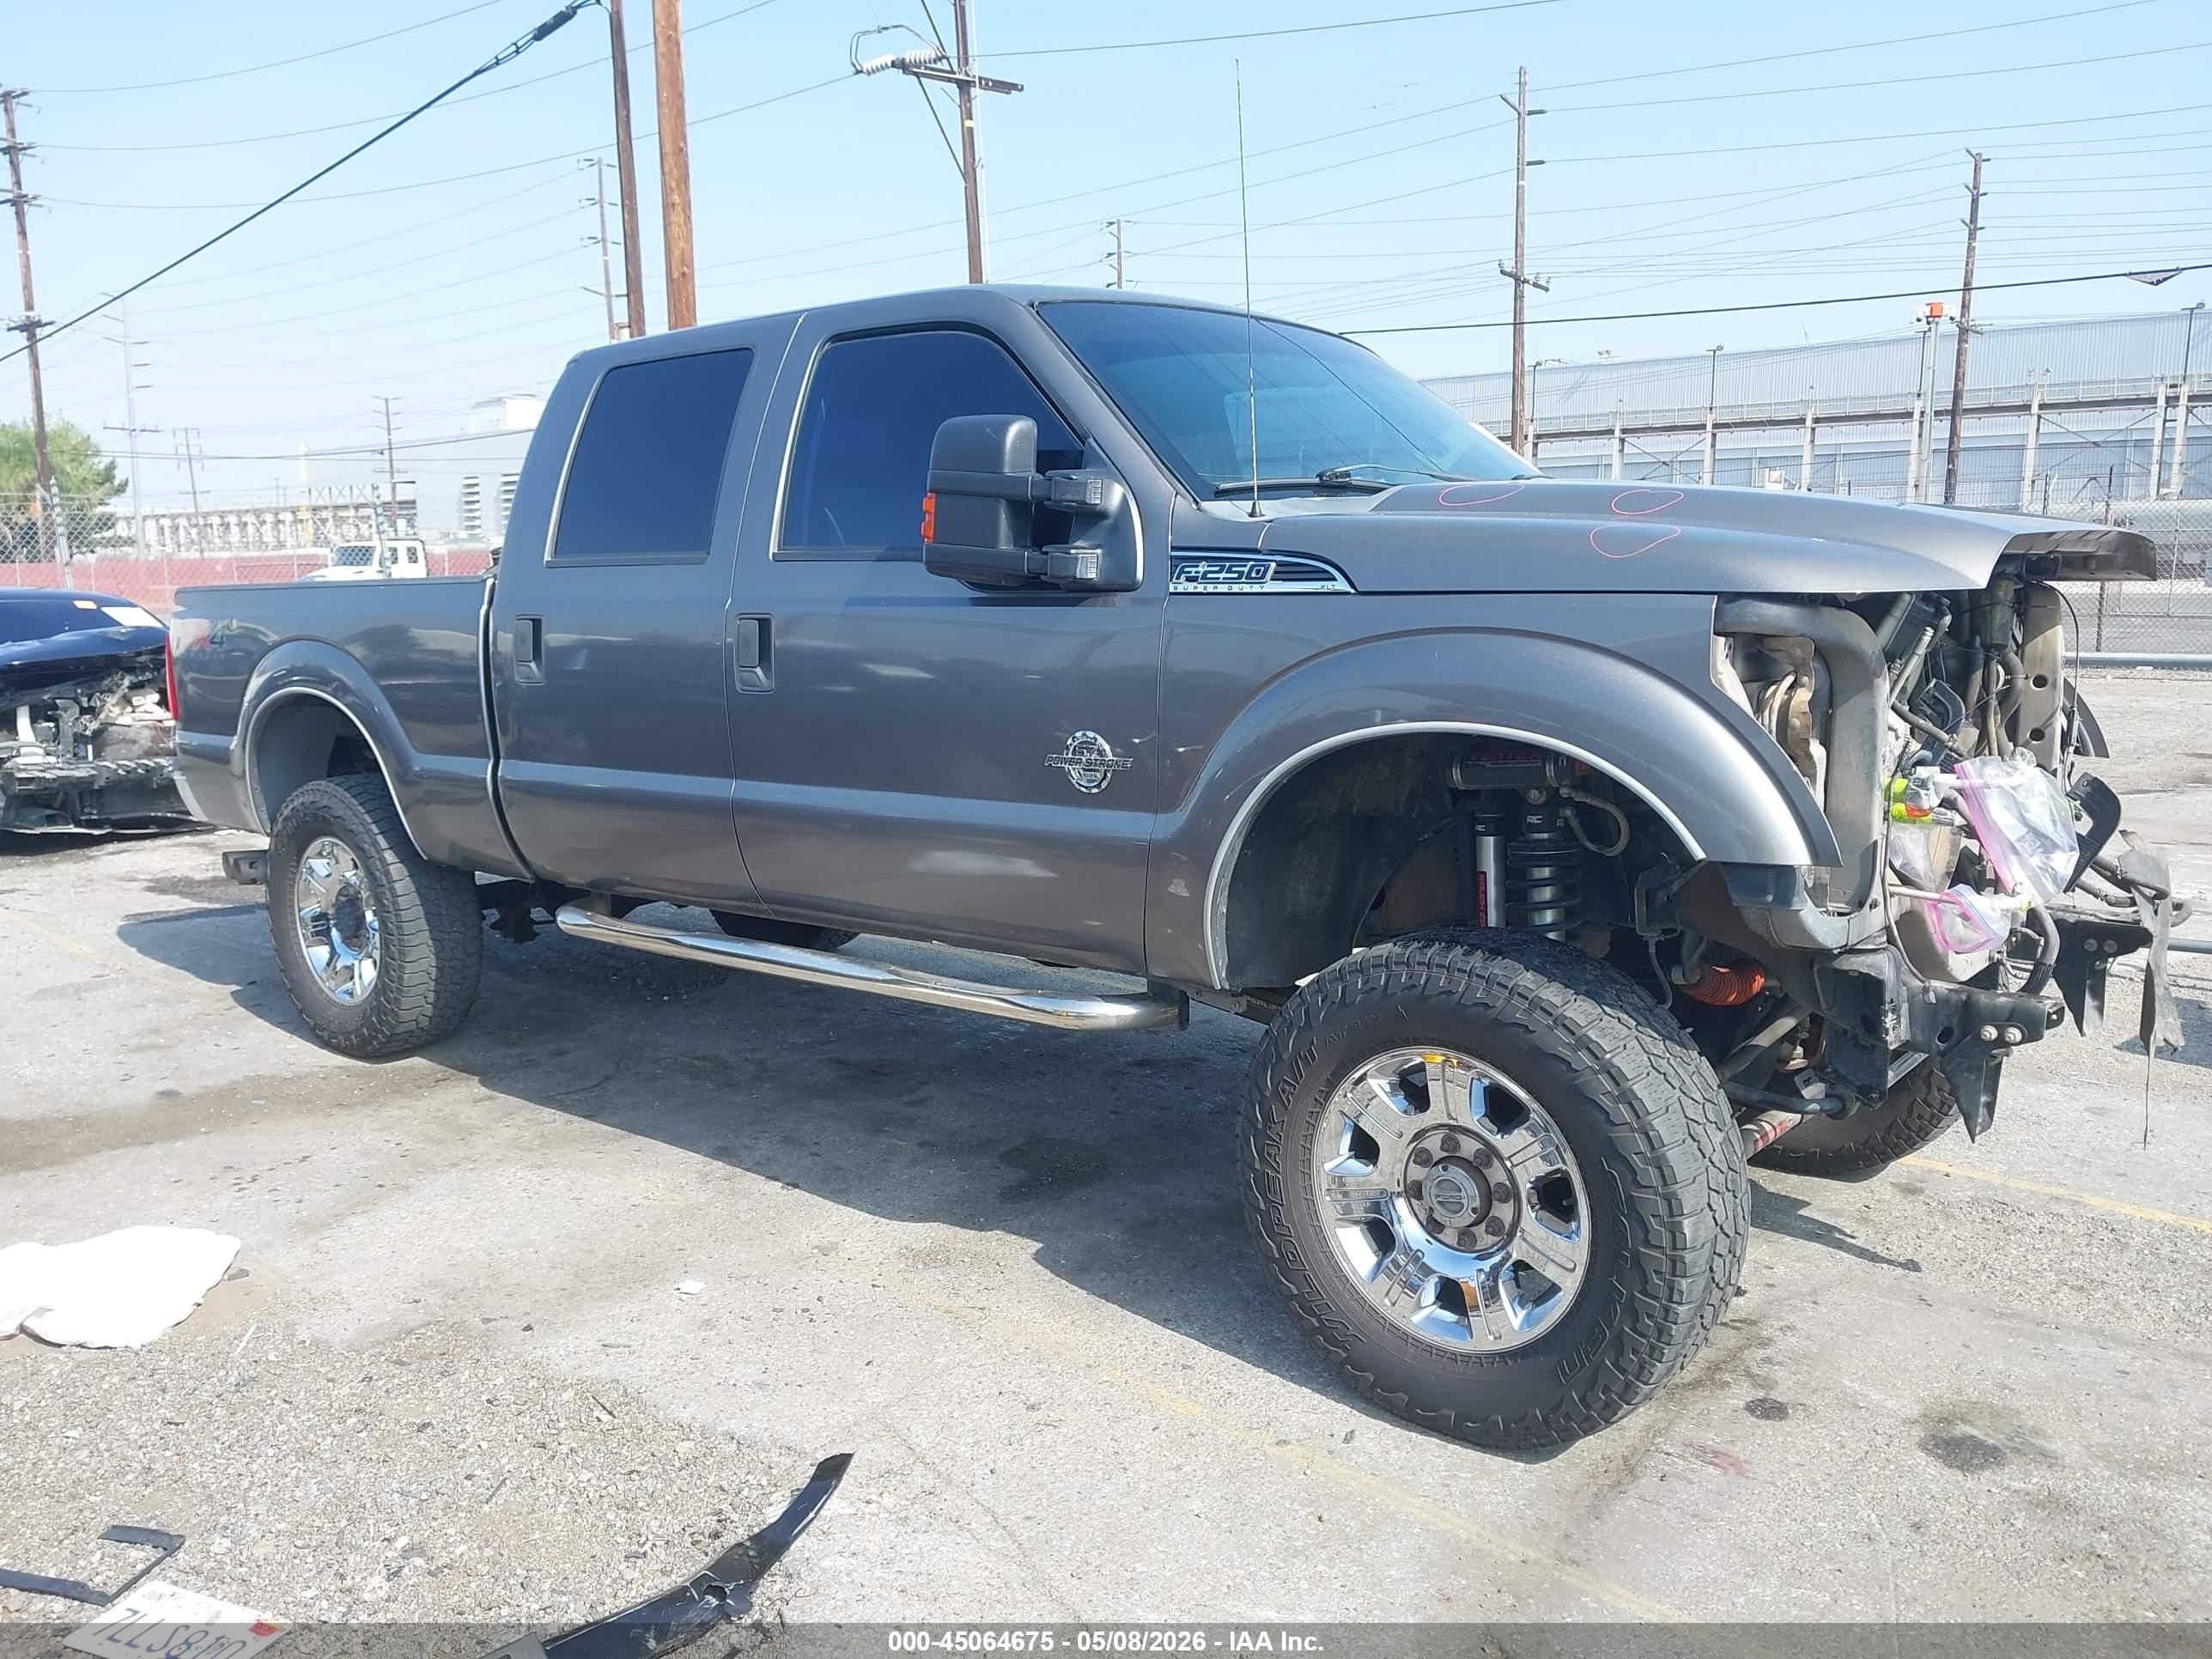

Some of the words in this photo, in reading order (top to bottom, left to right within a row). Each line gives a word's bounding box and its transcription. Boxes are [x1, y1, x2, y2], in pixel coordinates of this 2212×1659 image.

[1173, 562, 1277, 583] F-250
[1044, 755, 1083, 768] POWER
[1083, 757, 1133, 770] STROKE
